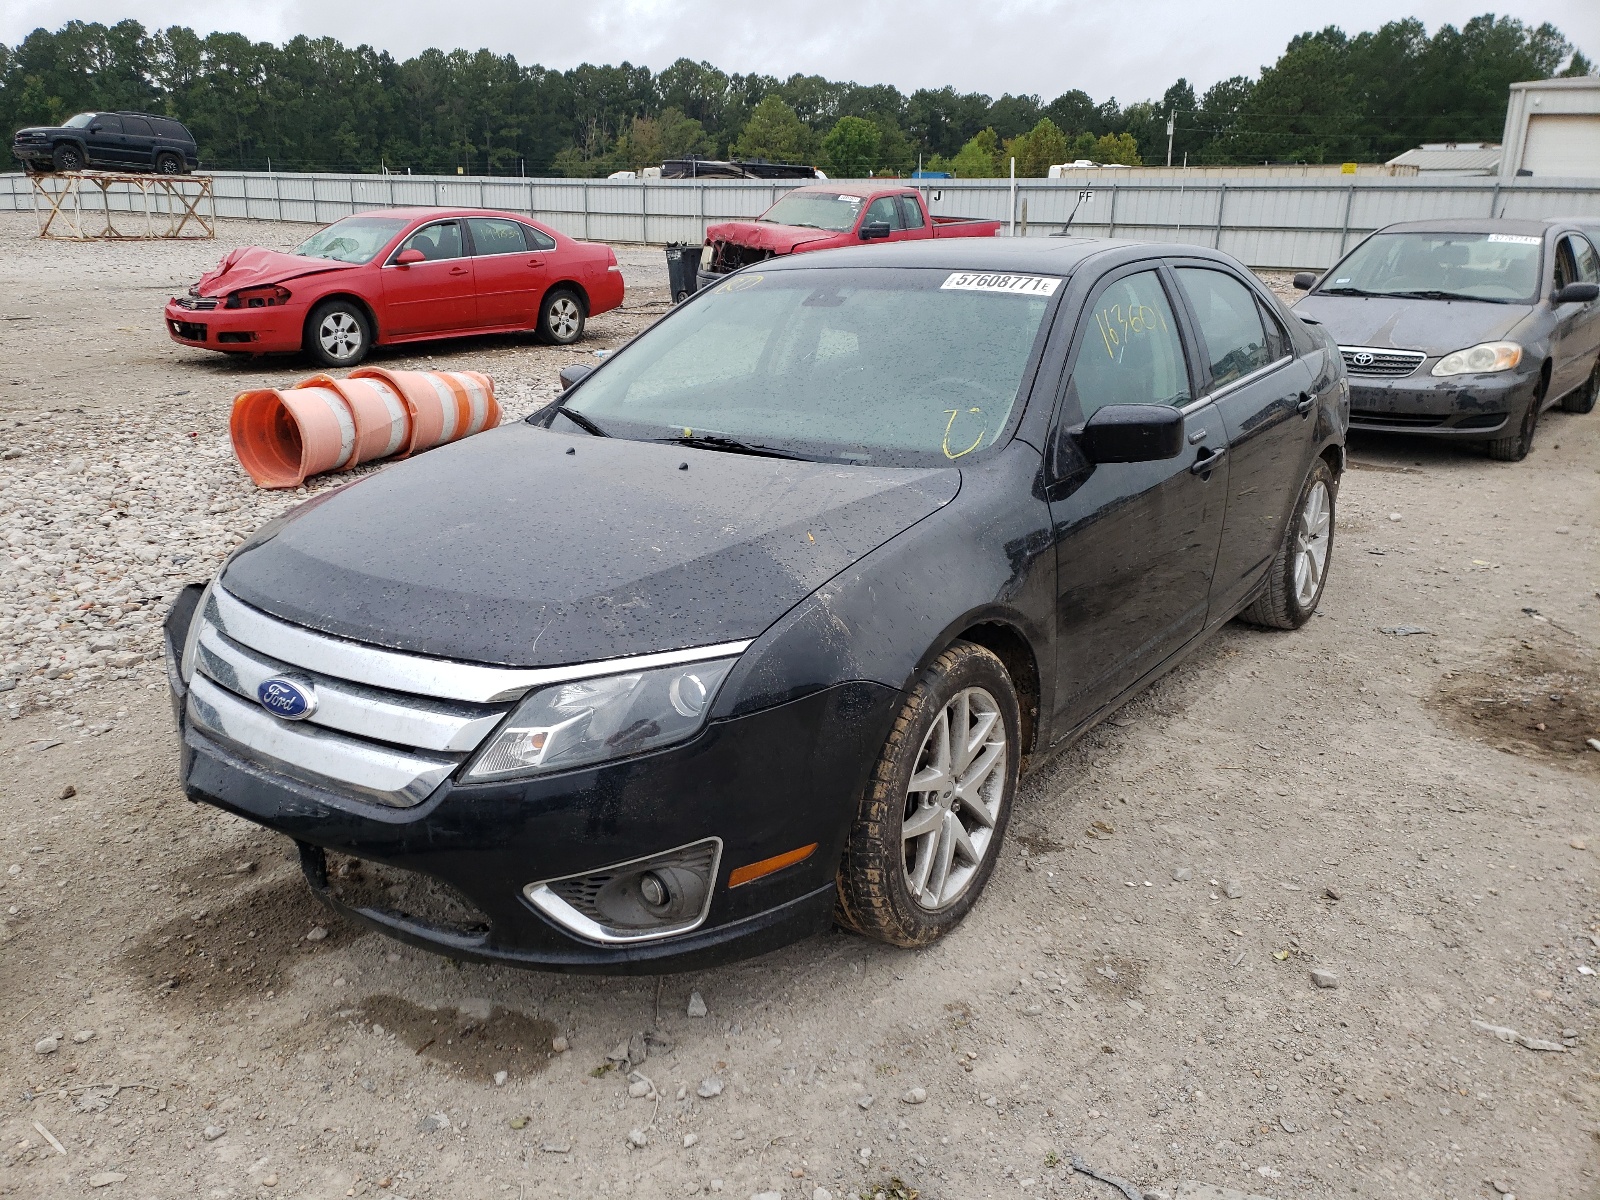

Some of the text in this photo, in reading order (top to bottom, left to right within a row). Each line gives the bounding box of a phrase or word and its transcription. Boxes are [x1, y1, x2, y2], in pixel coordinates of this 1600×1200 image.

[933, 190, 942, 201] J
[1078, 191, 1093, 202] FF
[956, 274, 1043, 291] 57608771
[263, 683, 297, 711] Ford
